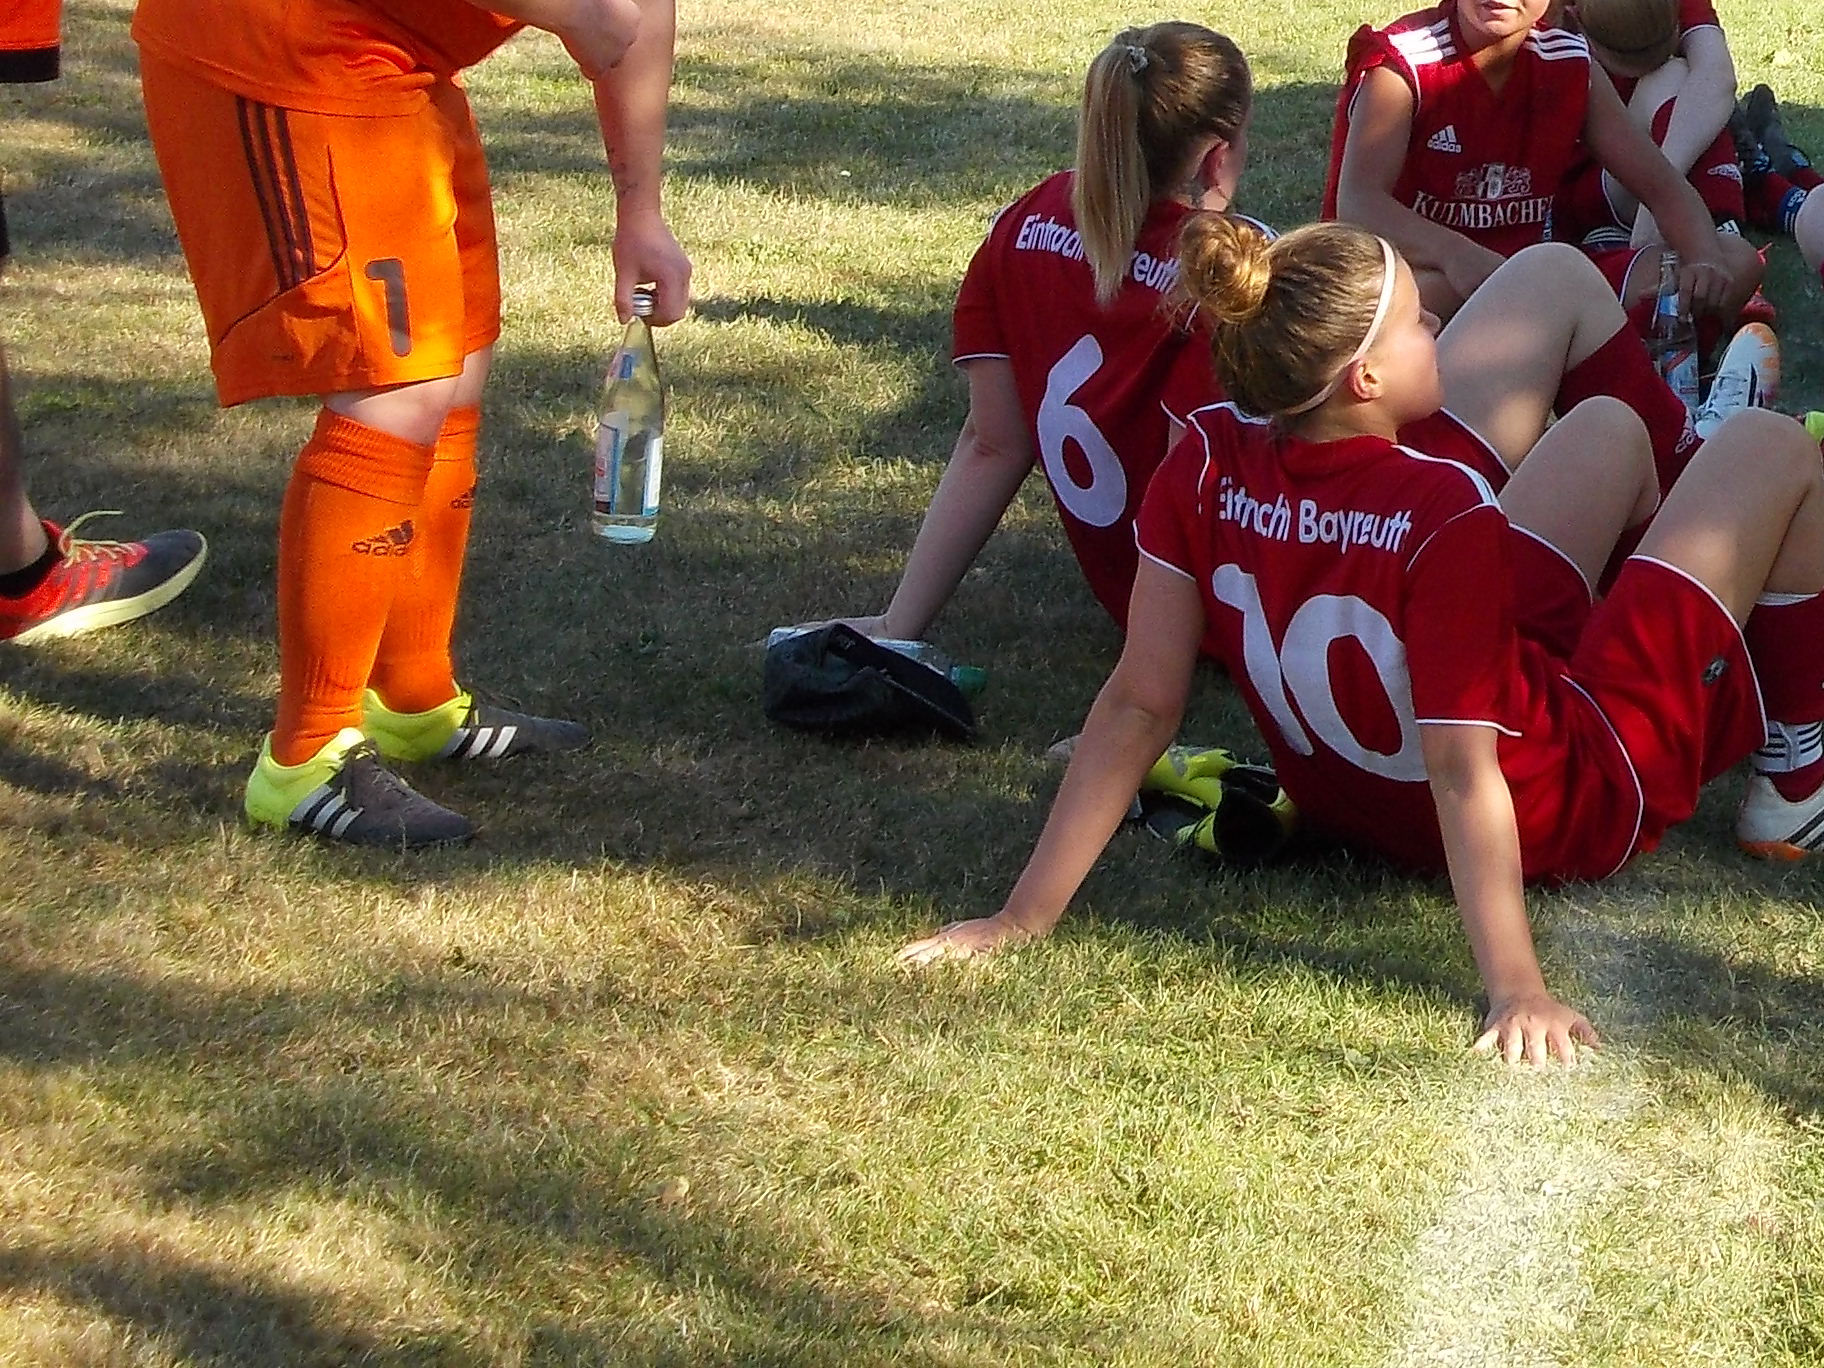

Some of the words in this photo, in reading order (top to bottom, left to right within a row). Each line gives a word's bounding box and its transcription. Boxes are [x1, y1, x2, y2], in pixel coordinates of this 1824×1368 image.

[1411, 190, 1554, 230] KULMBACHE
[365, 258, 413, 358] 1
[1036, 333, 1128, 528] 6
[1212, 562, 1429, 783] 10
